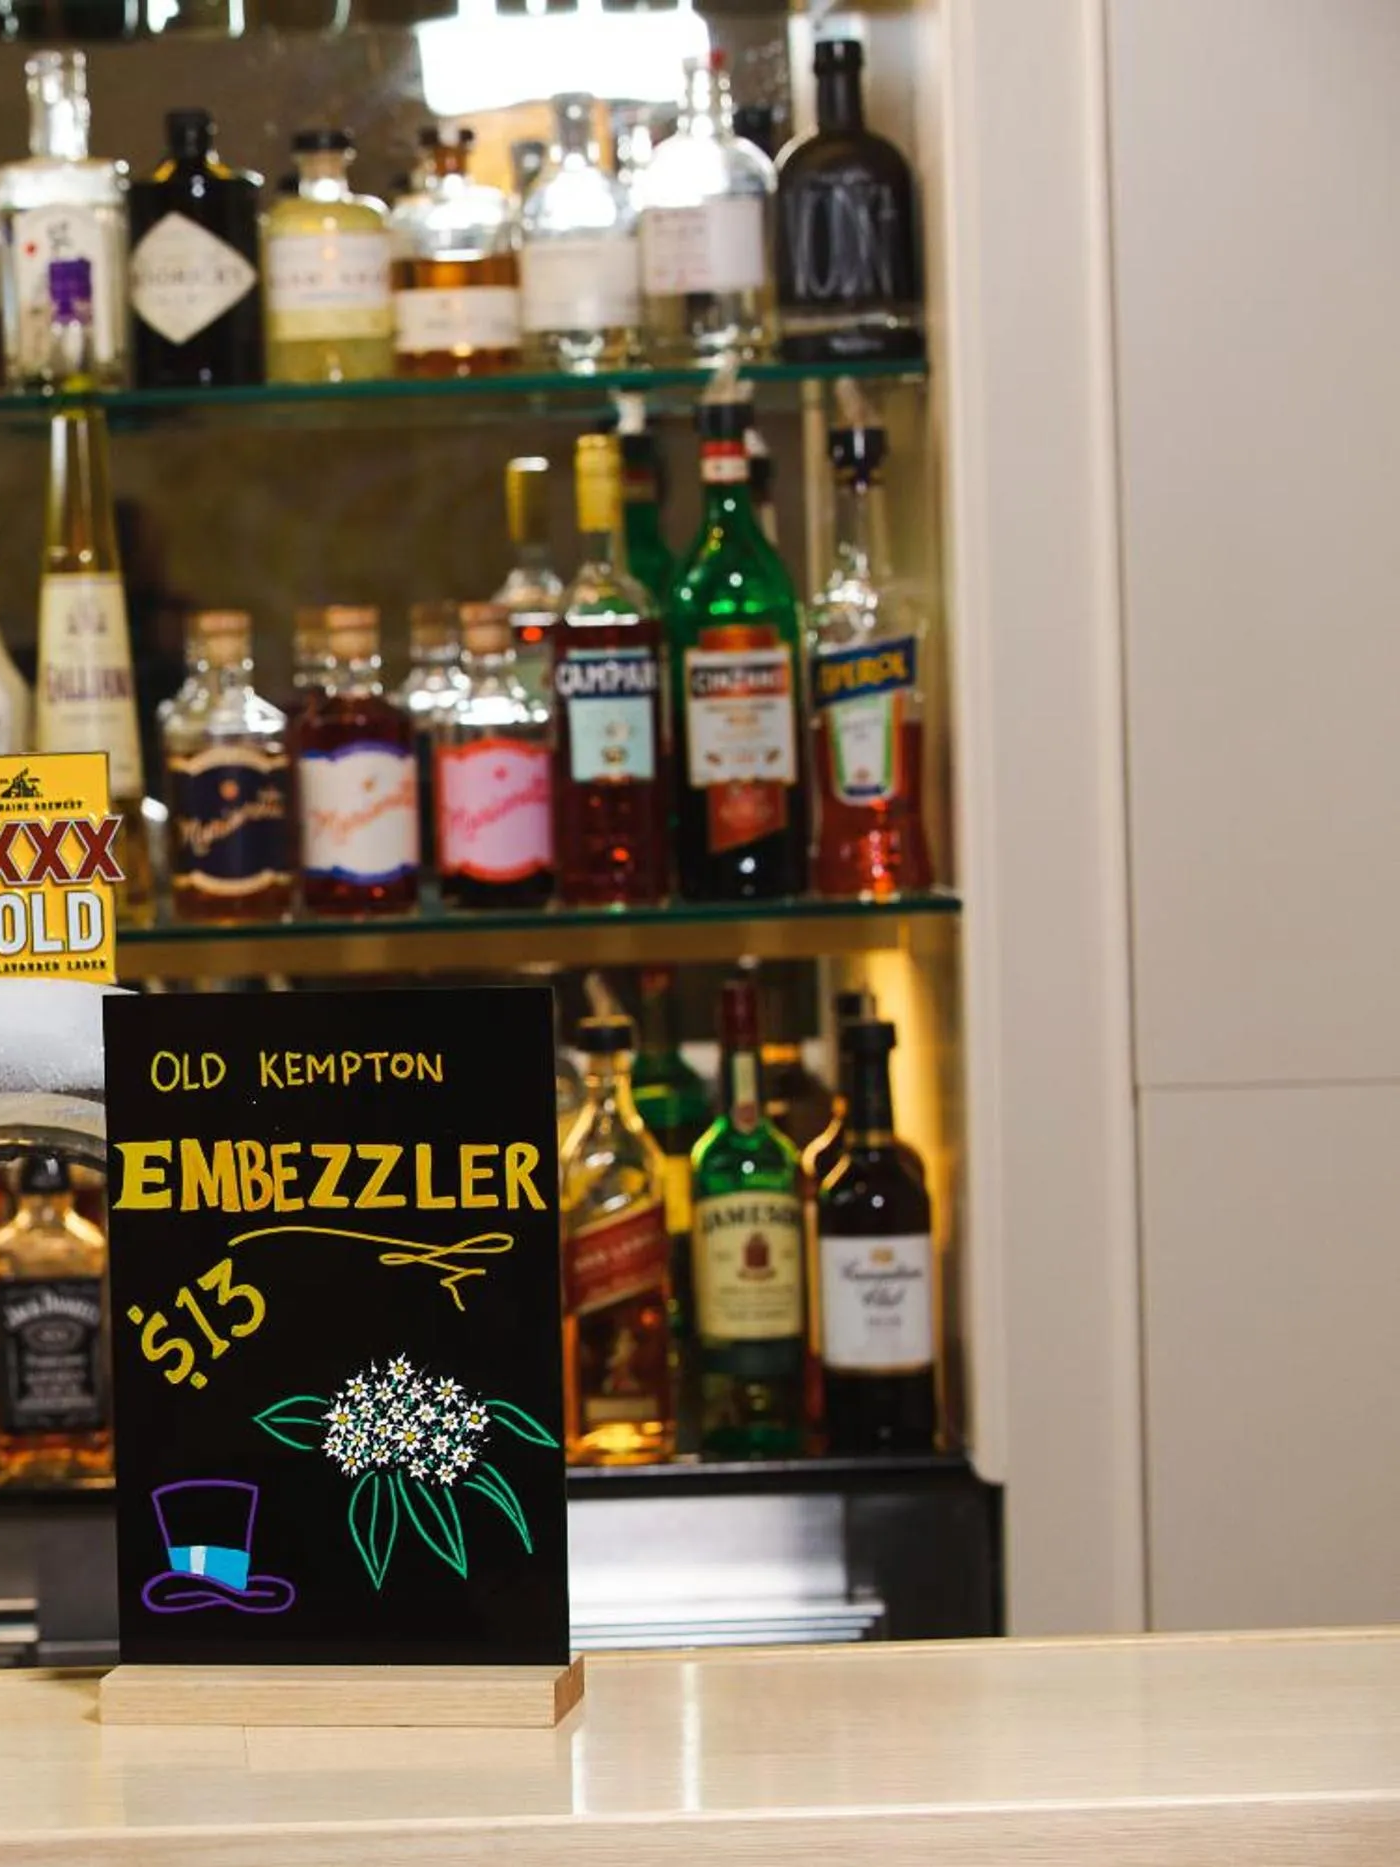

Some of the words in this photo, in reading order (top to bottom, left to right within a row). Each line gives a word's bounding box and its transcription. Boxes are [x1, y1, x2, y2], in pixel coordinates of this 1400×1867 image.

[151, 1050, 226, 1092] OLD
[259, 1051, 444, 1088] KEMPTON
[113, 1139, 547, 1213] EMBEZZLER
[126, 1257, 268, 1390] $13
